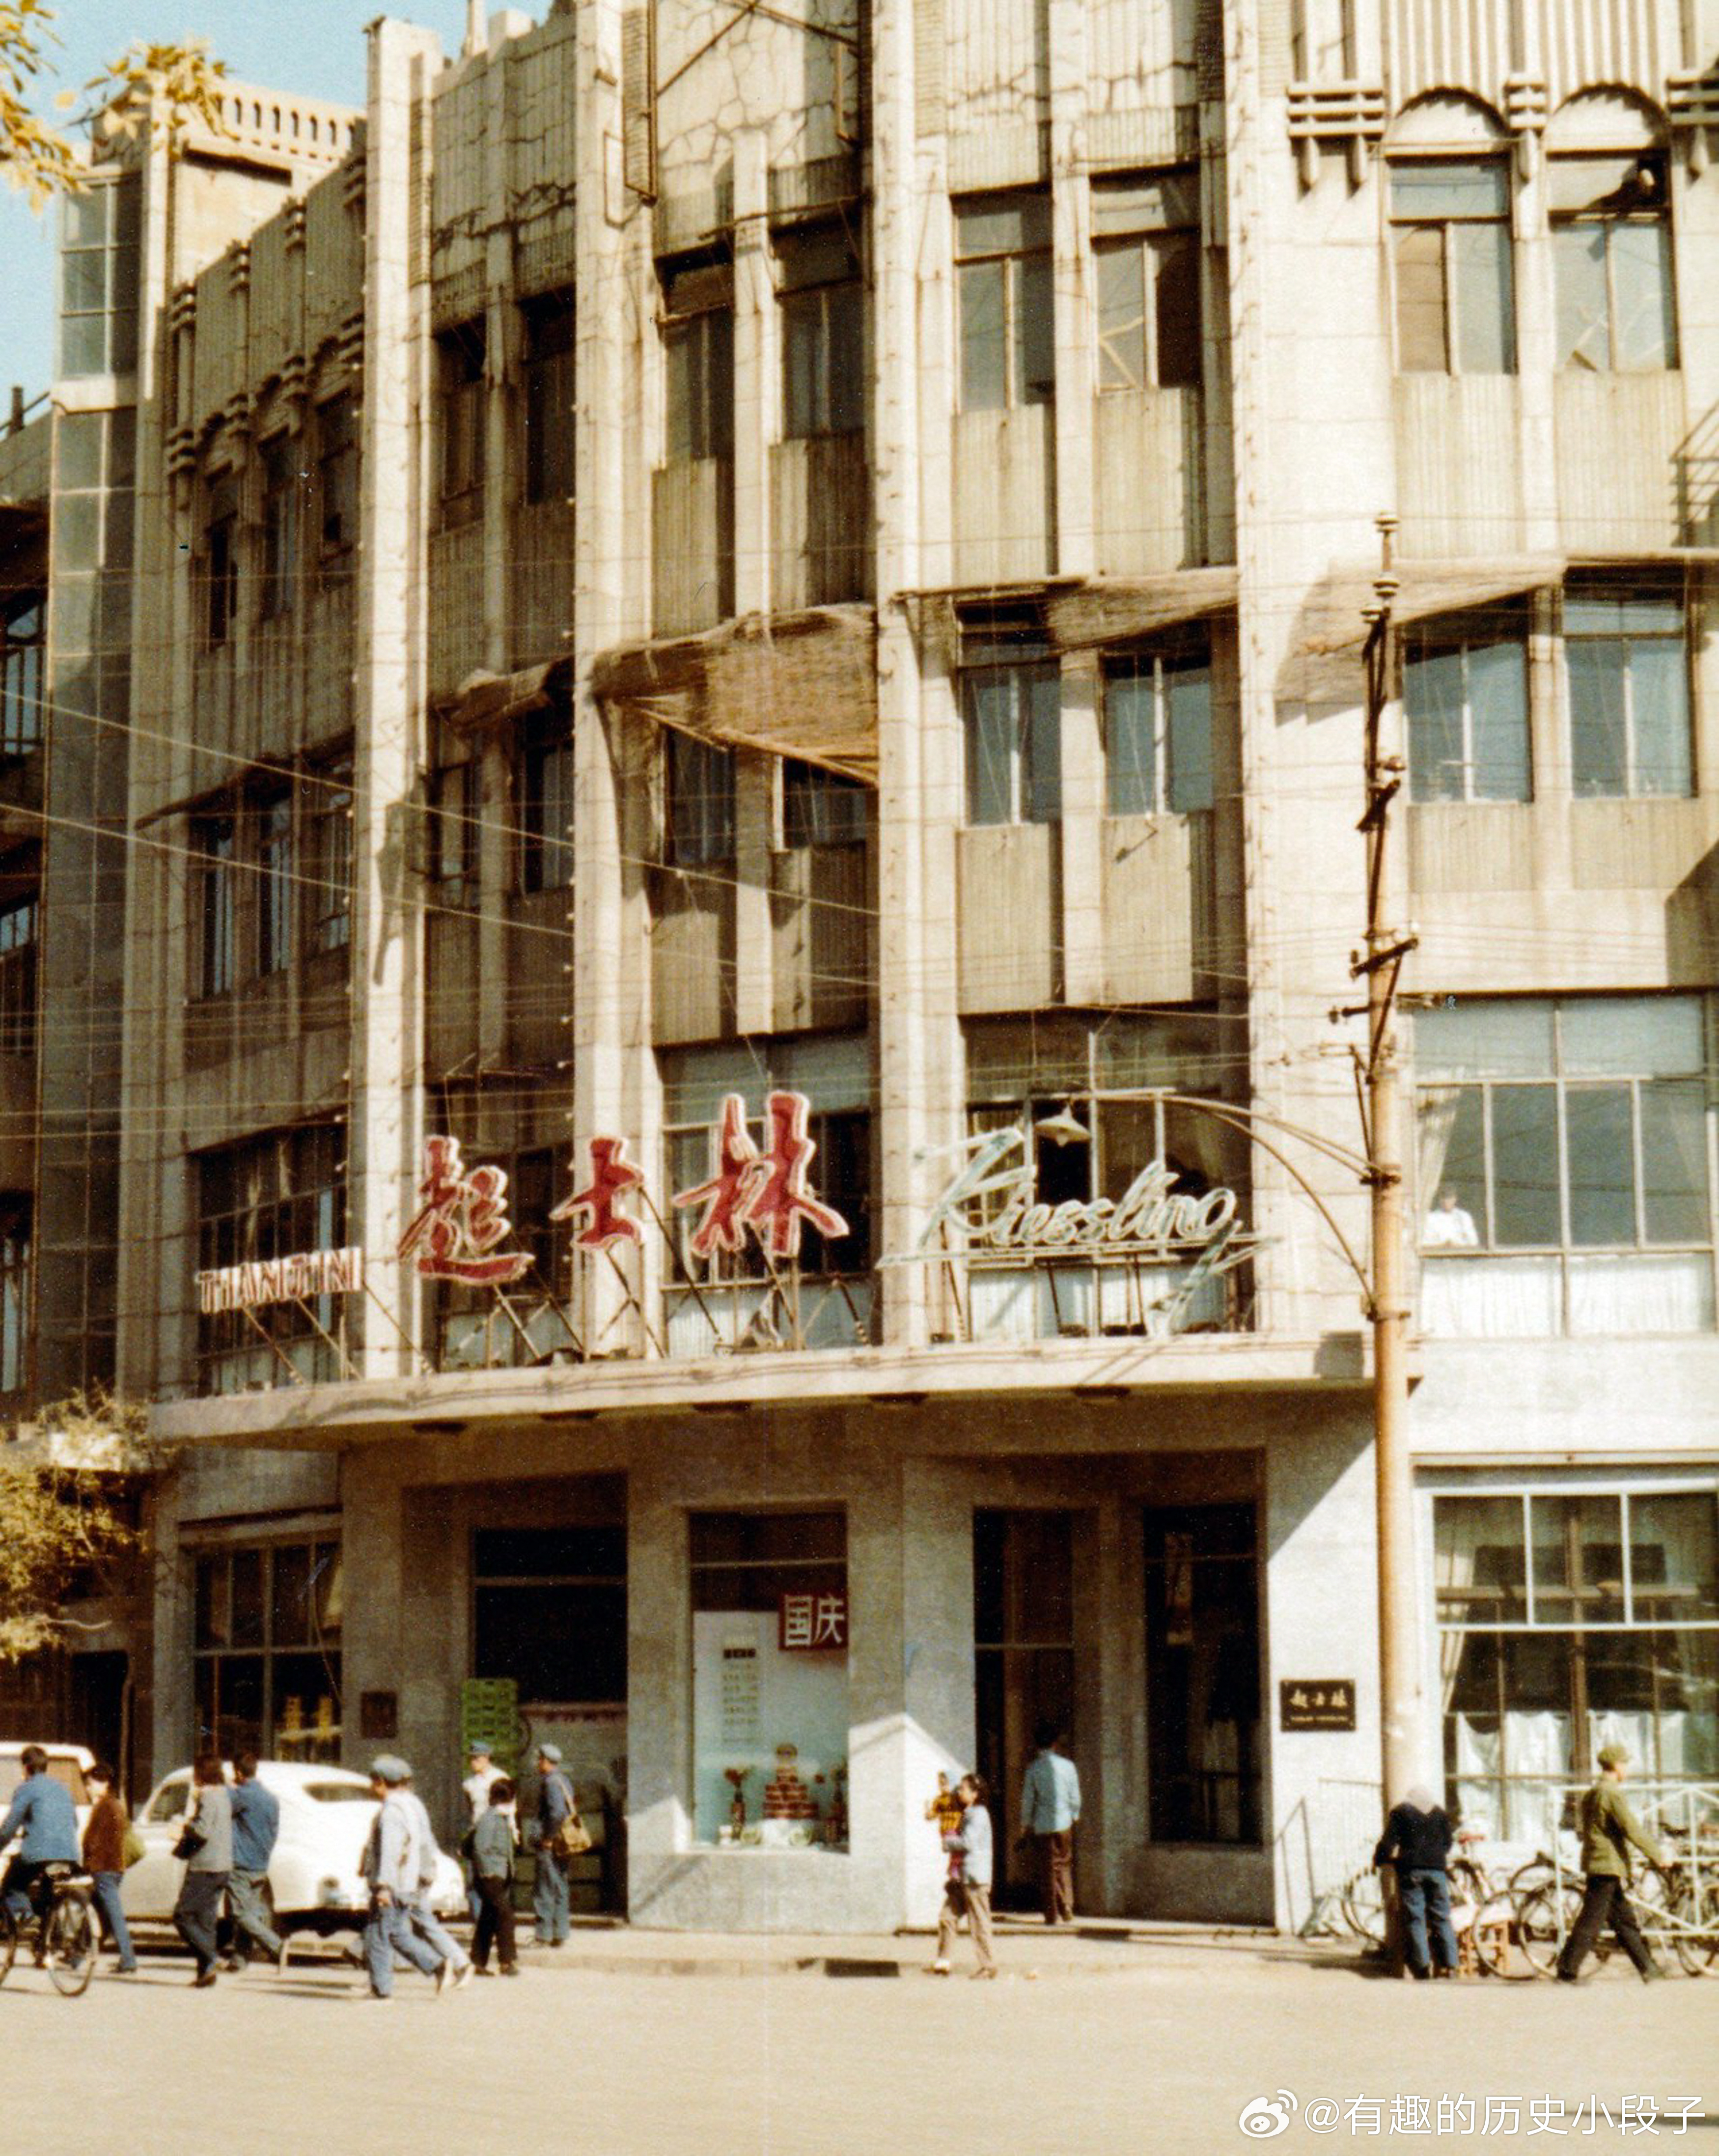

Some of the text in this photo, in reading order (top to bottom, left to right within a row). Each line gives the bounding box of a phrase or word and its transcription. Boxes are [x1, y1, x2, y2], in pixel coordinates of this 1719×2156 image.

[397, 1090, 850, 1286] 起士林
[784, 1594, 845, 1647] 国庆
